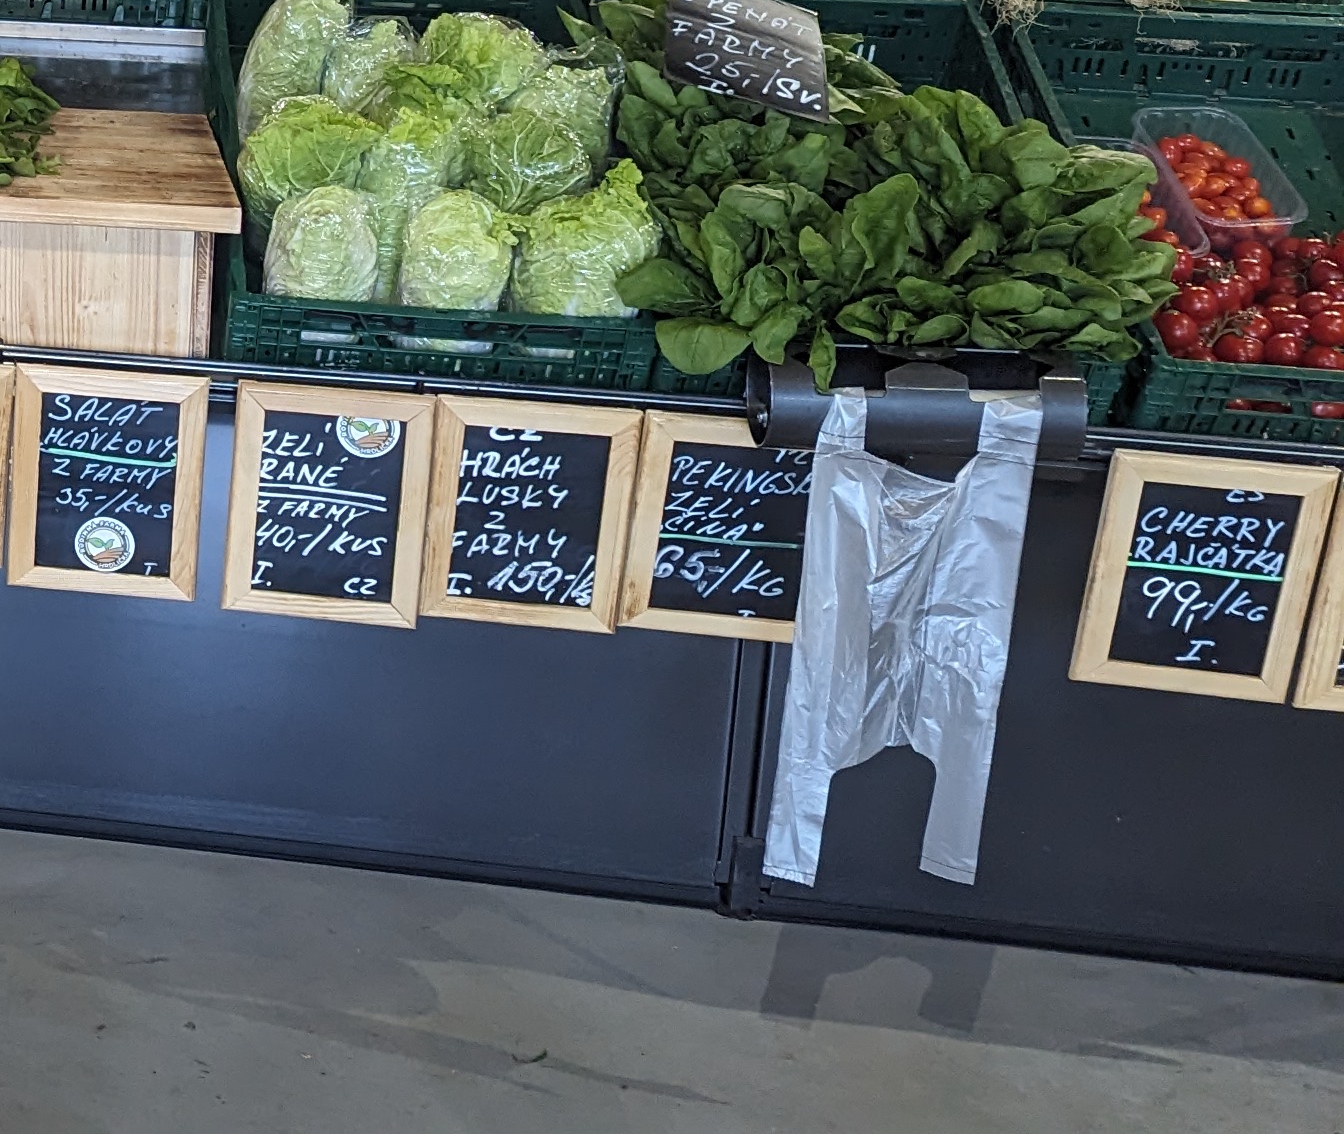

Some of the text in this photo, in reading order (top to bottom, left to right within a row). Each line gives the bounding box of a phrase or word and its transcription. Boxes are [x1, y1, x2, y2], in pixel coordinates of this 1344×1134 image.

[672, 19, 804, 69] FARMY
[47, 394, 164, 428] SALÁT
[44, 426, 179, 459] HLÁVKOVÝ
[262, 422, 332, 458] ZELÍ
[51, 458, 172, 490] Z FARMY
[260, 456, 349, 488] RANÉ
[459, 447, 562, 481] HRÁCH
[456, 484, 569, 510] LUSKY
[664, 490, 760, 520] ZELÍ
[277, 500, 371, 528] FARMY
[1140, 506, 1285, 548] CHERRY
[450, 527, 569, 559] FARMY
[1133, 536, 1285, 578] RAJČÁTKA
[343, 576, 378, 596] CZ
